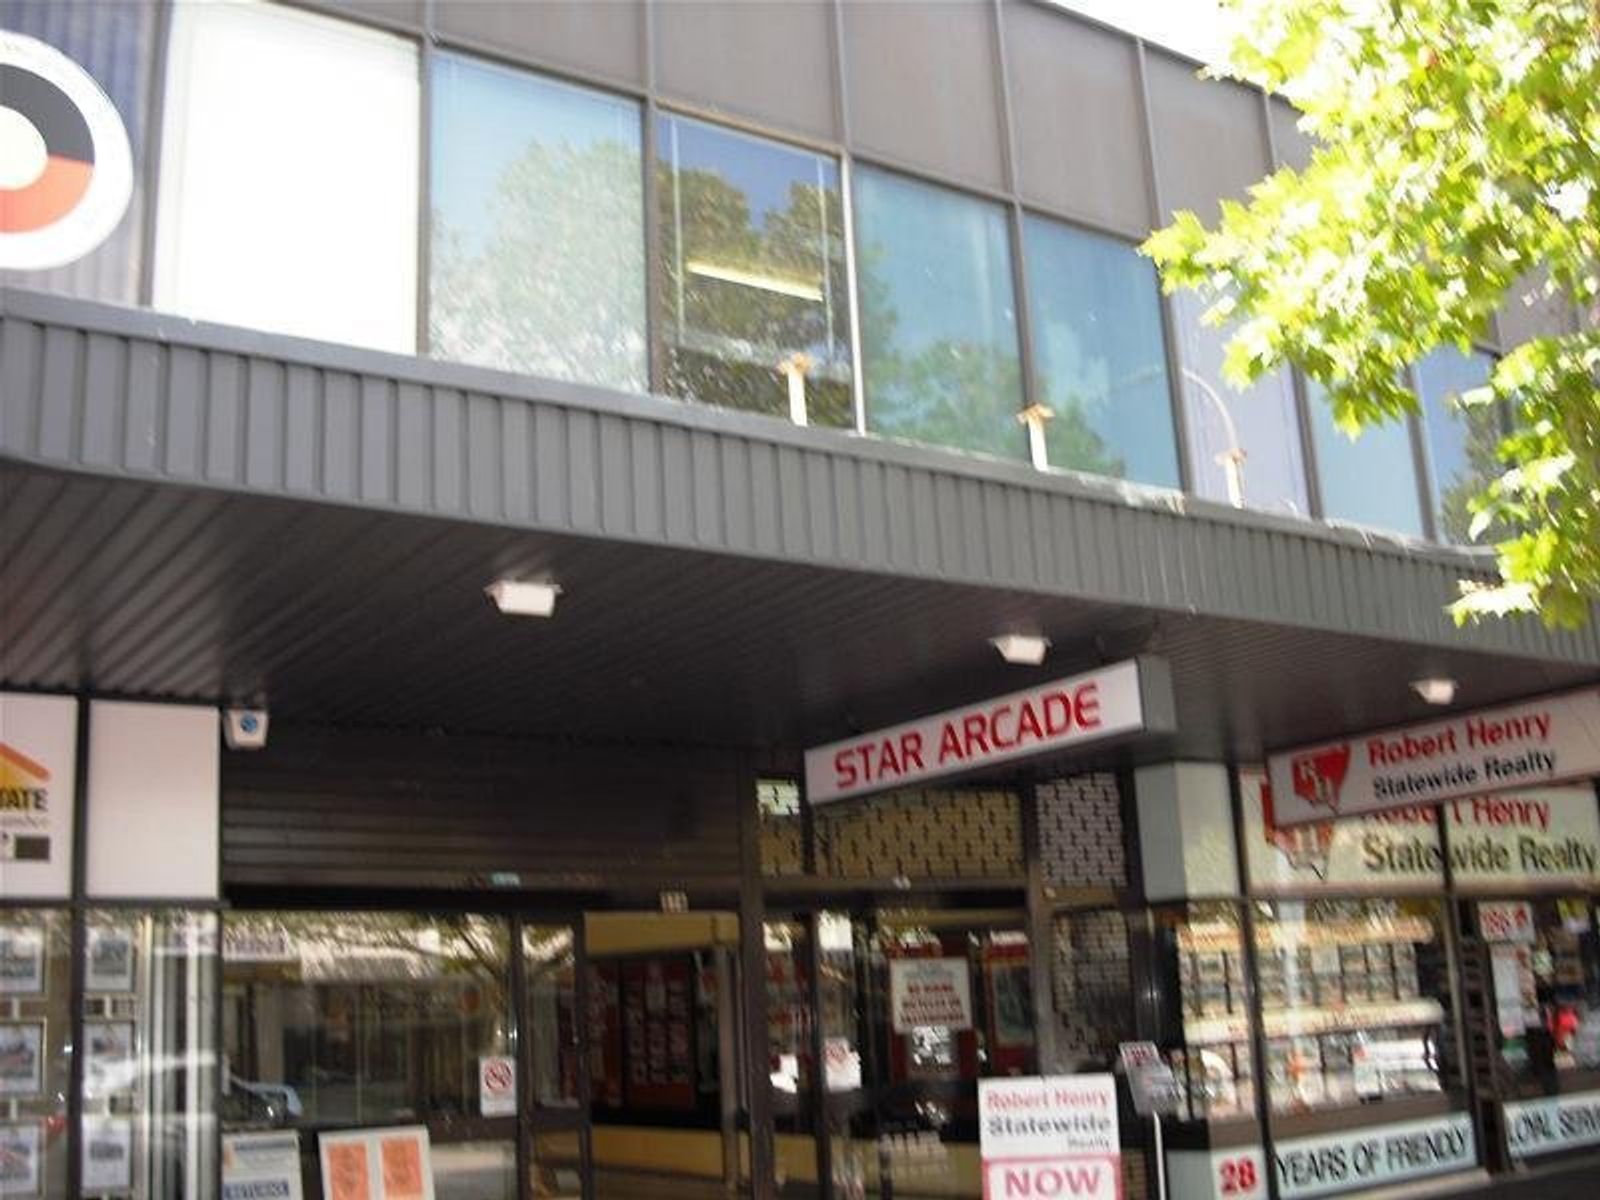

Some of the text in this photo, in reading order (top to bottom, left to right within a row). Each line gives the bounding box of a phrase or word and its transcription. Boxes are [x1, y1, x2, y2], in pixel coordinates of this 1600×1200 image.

[834, 681, 1101, 789] STAR ARCADE
[1367, 711, 1552, 769] Robert Henry
[1372, 749, 1557, 801] Statewide Realty
[1471, 796, 1549, 833] Henry
[1361, 832, 1598, 875] Statewide Realty
[986, 1087, 1111, 1112] Robert Henry
[987, 1113, 1112, 1138] Statewide
[1004, 1165, 1101, 1198] NOW
[1219, 1154, 1258, 1199] 28
[1274, 1143, 1347, 1188] YEARS
[1350, 1136, 1381, 1178] OF
